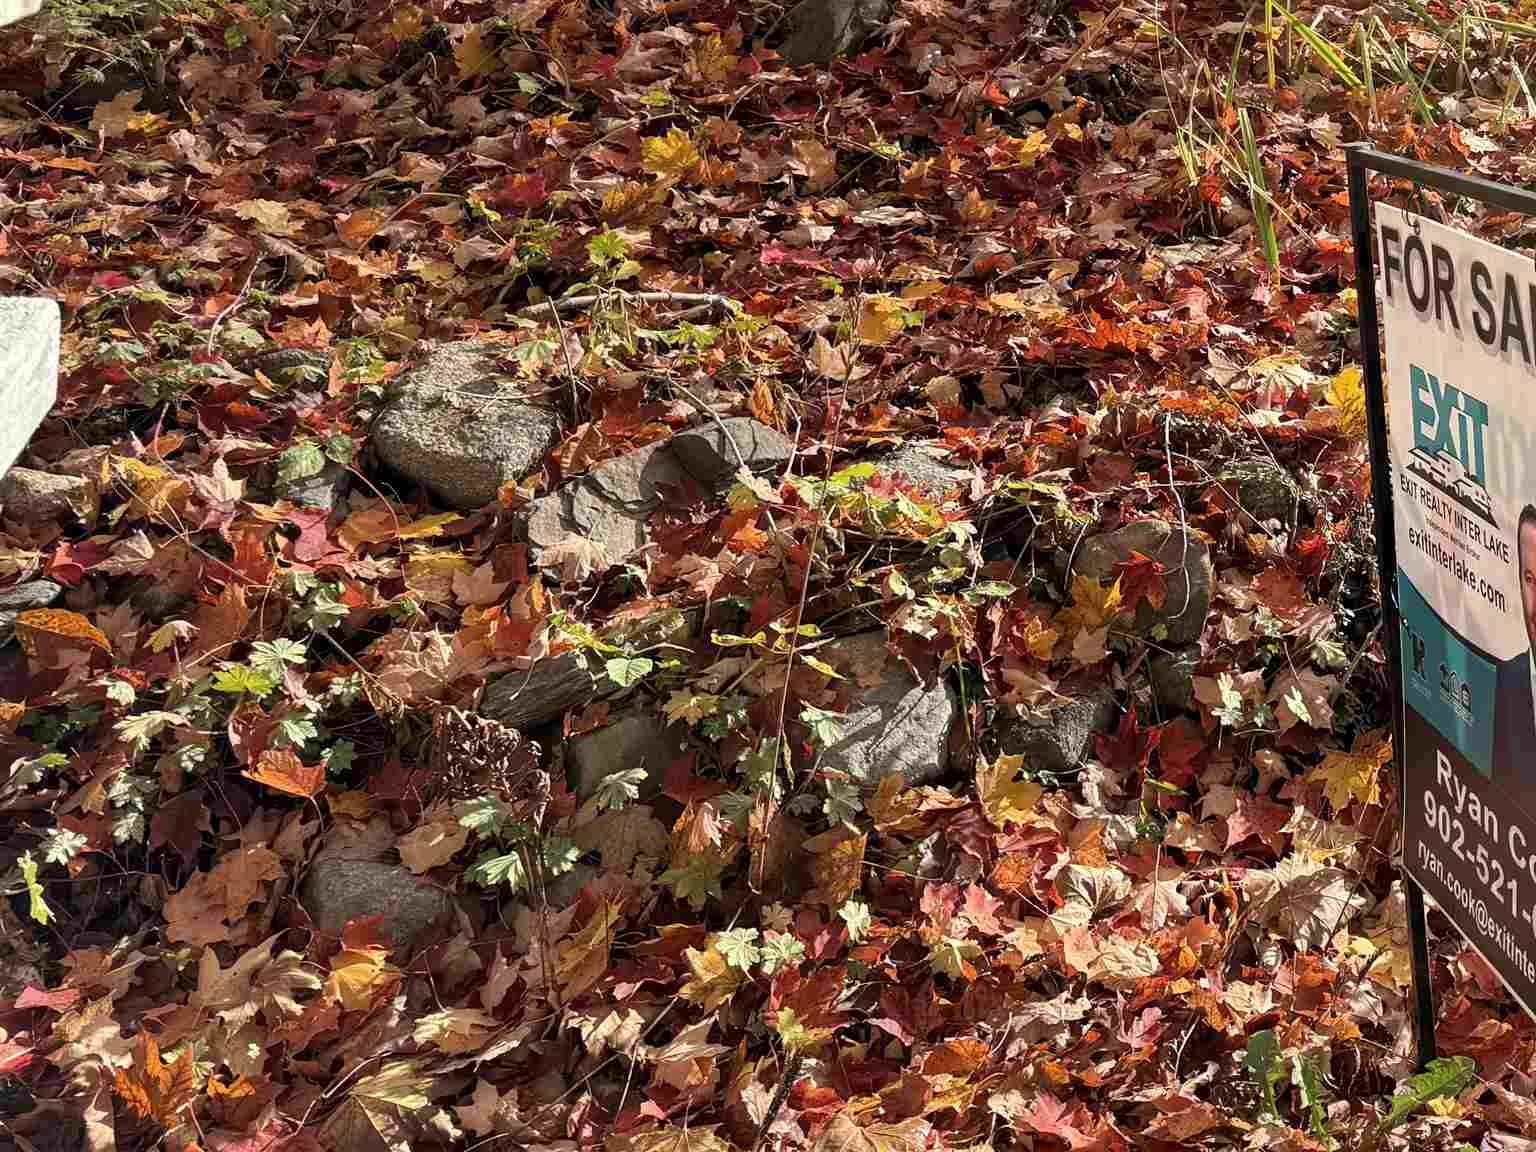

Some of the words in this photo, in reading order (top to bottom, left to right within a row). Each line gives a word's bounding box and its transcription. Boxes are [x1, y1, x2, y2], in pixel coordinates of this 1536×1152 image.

[1380, 224, 1461, 332] FOR
[1400, 474, 1417, 499] EXIT
[1420, 486, 1452, 524] REALTY
[1454, 510, 1482, 545] INTER
[1483, 528, 1510, 564] LAKE
[1408, 527, 1506, 613] exitinterlake.com
[1436, 748, 1500, 845] Ryan
